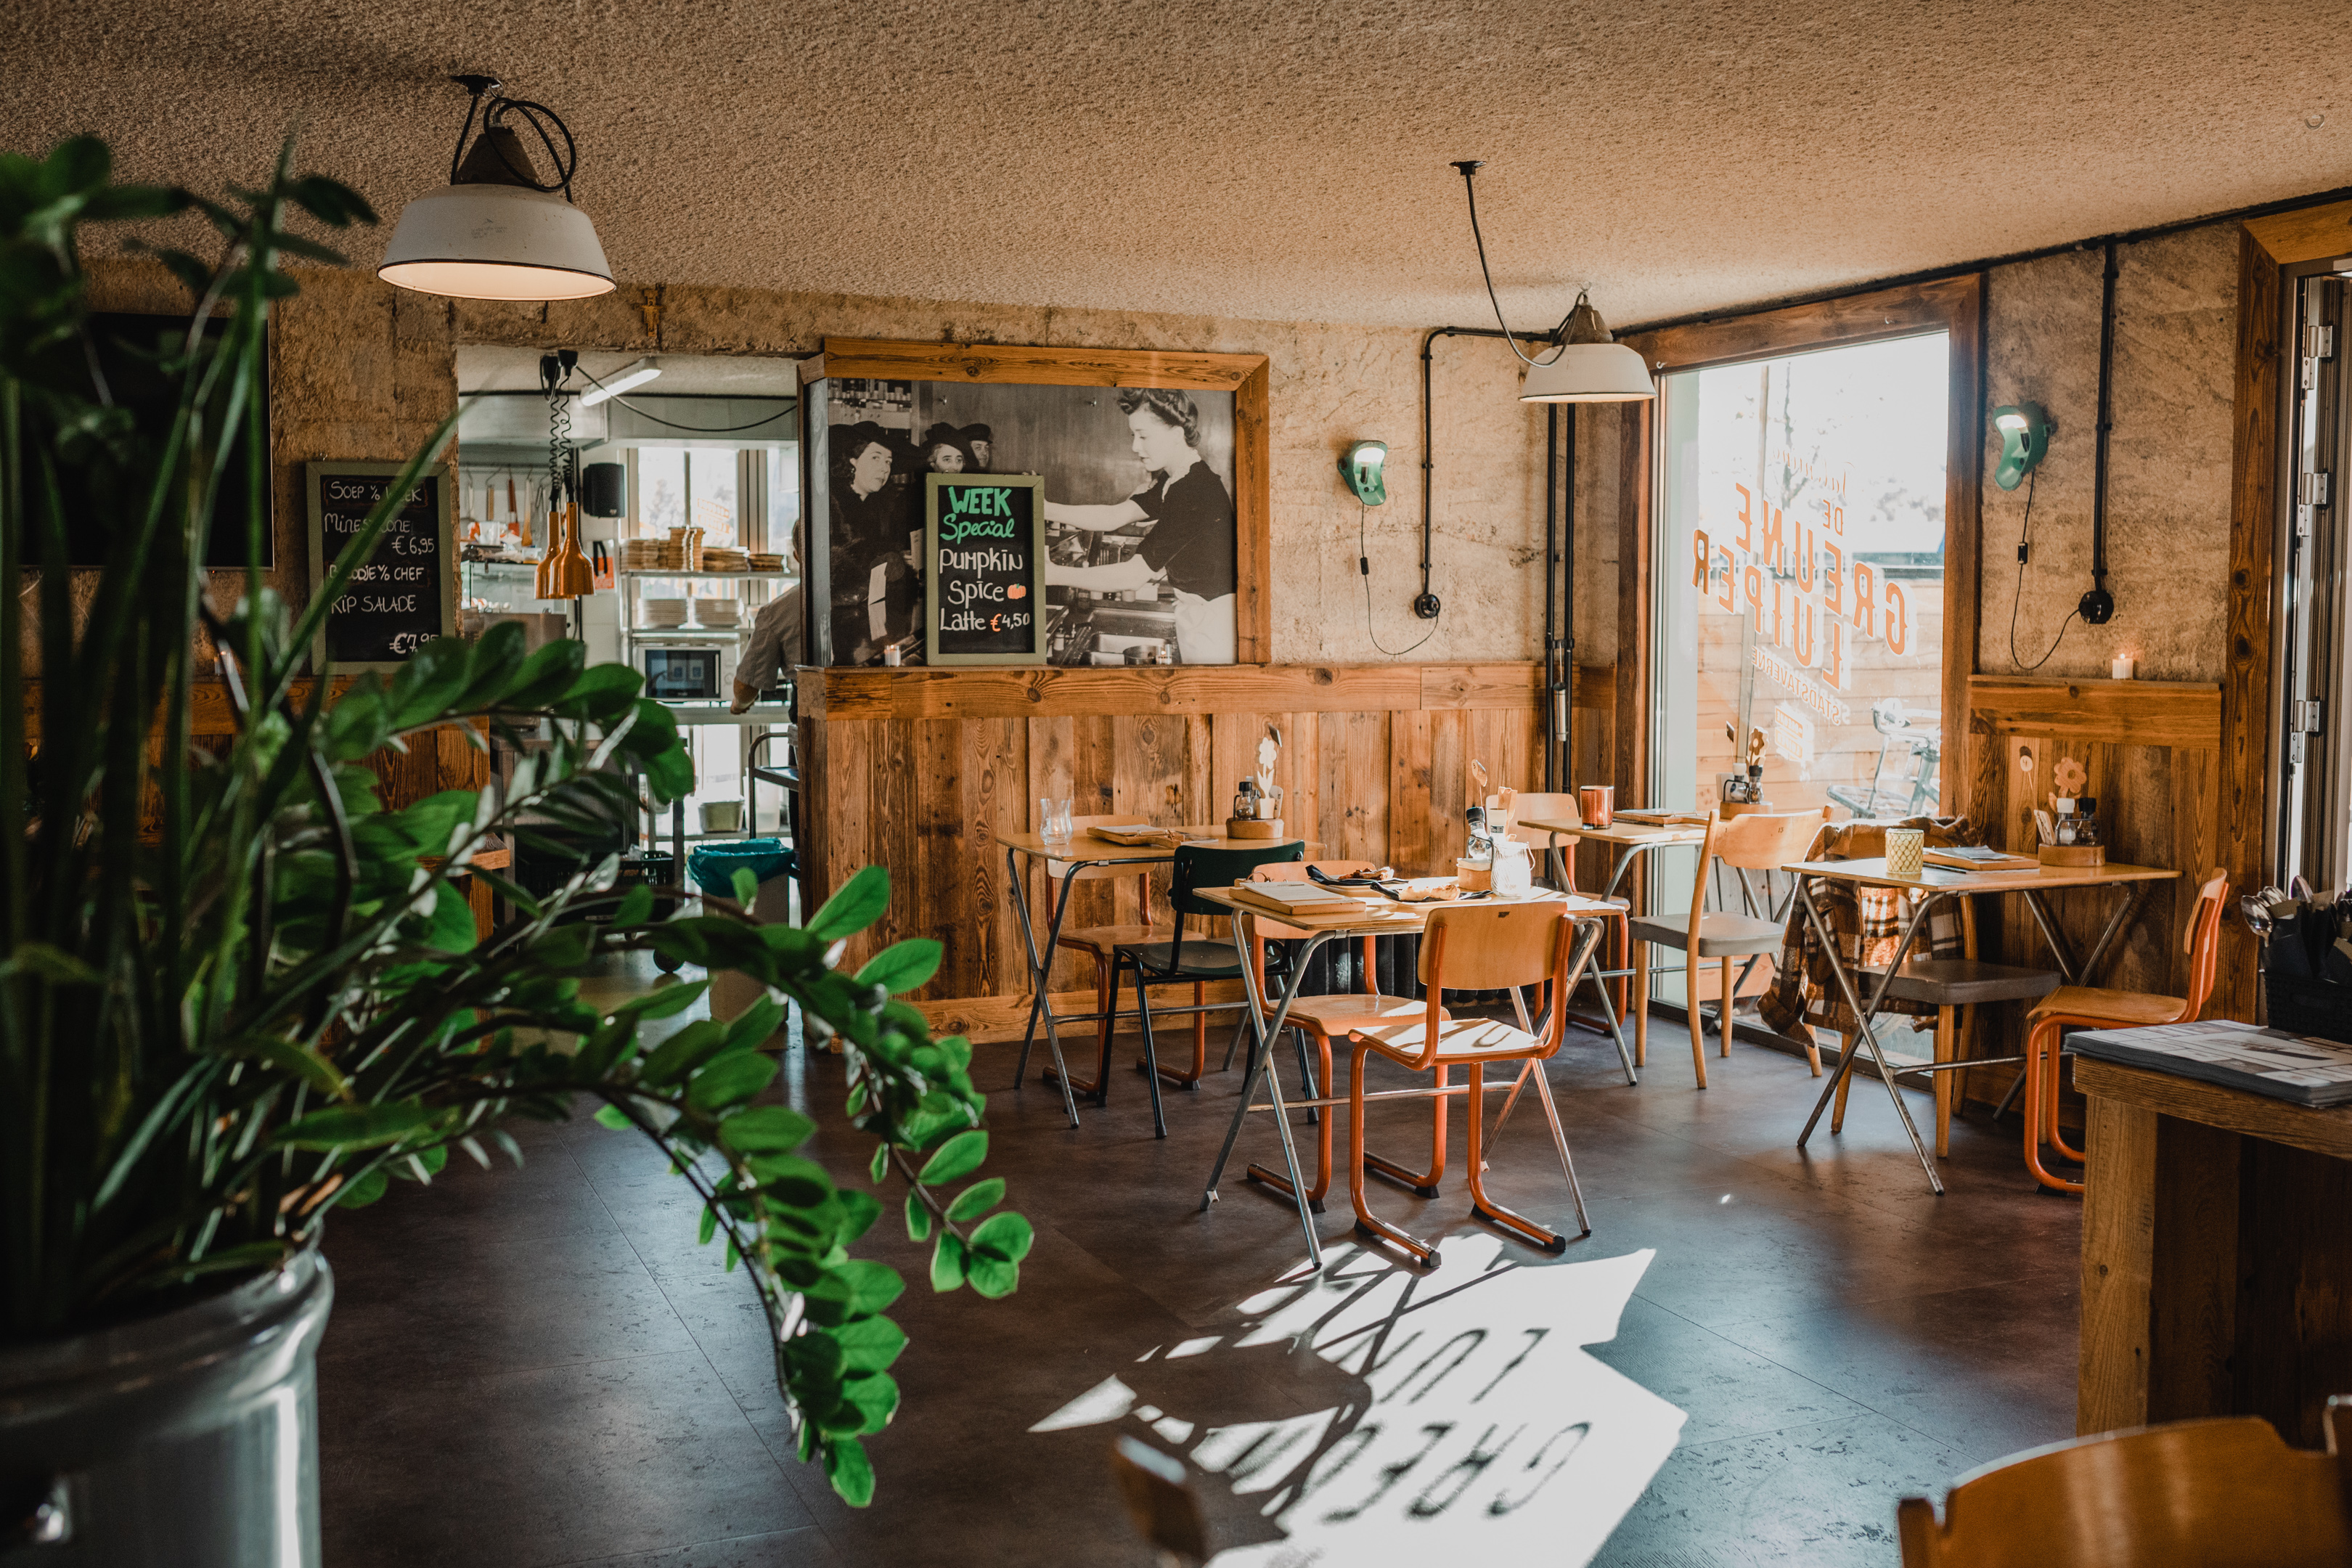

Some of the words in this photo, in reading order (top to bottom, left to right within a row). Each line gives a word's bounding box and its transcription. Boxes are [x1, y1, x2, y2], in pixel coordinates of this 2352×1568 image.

[948, 486, 1012, 517] WEEK
[940, 513, 1015, 544] Special
[394, 566, 425, 581] CHEF
[361, 595, 416, 613] SALADE
[947, 580, 1005, 609] Spice
[939, 608, 987, 631] Latte
